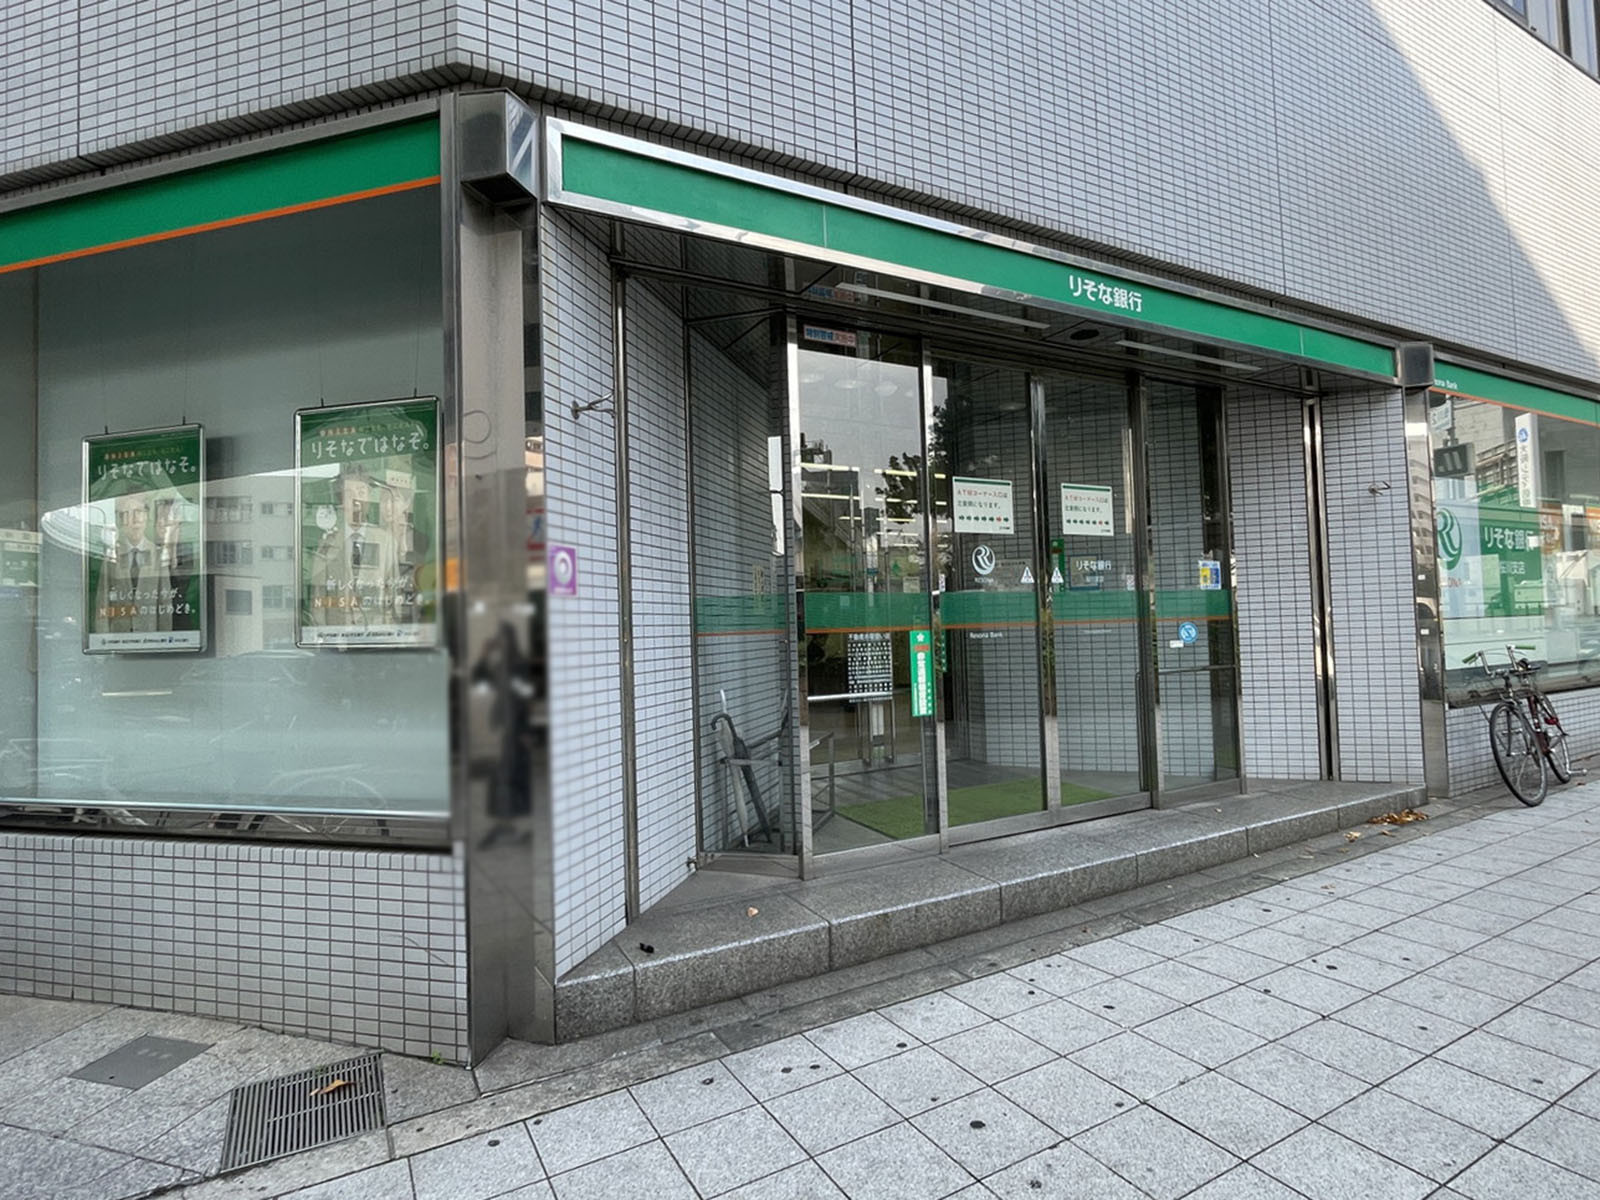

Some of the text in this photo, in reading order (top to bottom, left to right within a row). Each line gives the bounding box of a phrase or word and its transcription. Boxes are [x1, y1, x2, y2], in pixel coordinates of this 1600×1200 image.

[1068, 275, 1143, 313] りそな銀行
[1075, 559, 1112, 572] りそな銀行
[98, 603, 197, 618] NISAのはじめどき。
